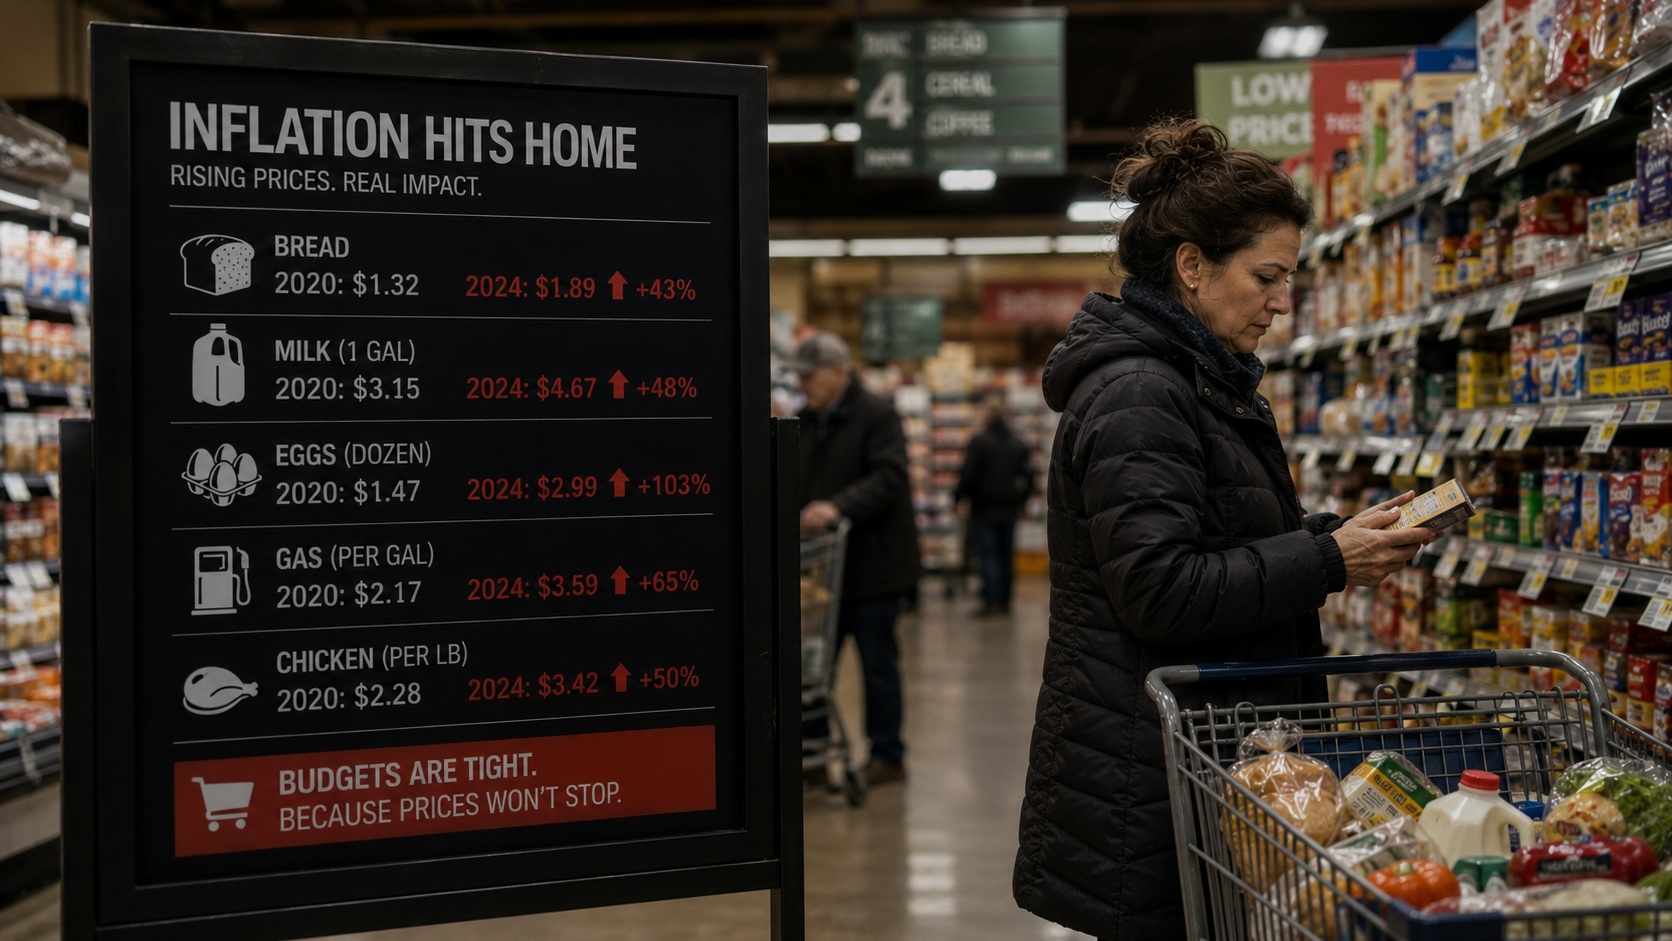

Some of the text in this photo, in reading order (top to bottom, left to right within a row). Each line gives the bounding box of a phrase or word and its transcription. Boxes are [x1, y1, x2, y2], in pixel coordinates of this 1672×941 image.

[926, 71, 996, 97] CEREAL
[1231, 72, 1312, 106] LOW
[866, 71, 913, 130] 4
[170, 102, 636, 169] INFLATION HITS HOME
[926, 111, 994, 136] COFFEE
[171, 165, 481, 196] RISING PRICES. REAL IMPACT.
[275, 235, 349, 257] BREAD
[275, 270, 418, 297] 2020: $1.32
[466, 274, 695, 300] 2024: $1.89 +43%
[276, 339, 414, 365] MILK (1 GAL)
[276, 375, 419, 402] 2020: $3.15
[467, 375, 697, 400] 2024: $4.67 +48%
[276, 441, 430, 468] EGGS (DOZEN)
[276, 478, 420, 505] 2020: $1.47
[468, 474, 710, 500] 2024: $2.99 +103%
[277, 542, 433, 571] GAS (PER GAL)
[277, 580, 421, 608] 2020: $2.17
[468, 570, 698, 600] 2024: $3.59 +65%
[277, 641, 467, 673] CHICKEN (PER LB)
[469, 666, 699, 700] 2024: $3.42 +50%
[278, 683, 420, 712] 2020: $2.28
[280, 753, 536, 795] BUDGETS ARE TIGHT.
[281, 800, 391, 831] BECAUSE
[401, 793, 478, 821] PRICES
[566, 782, 621, 807] STOP.
